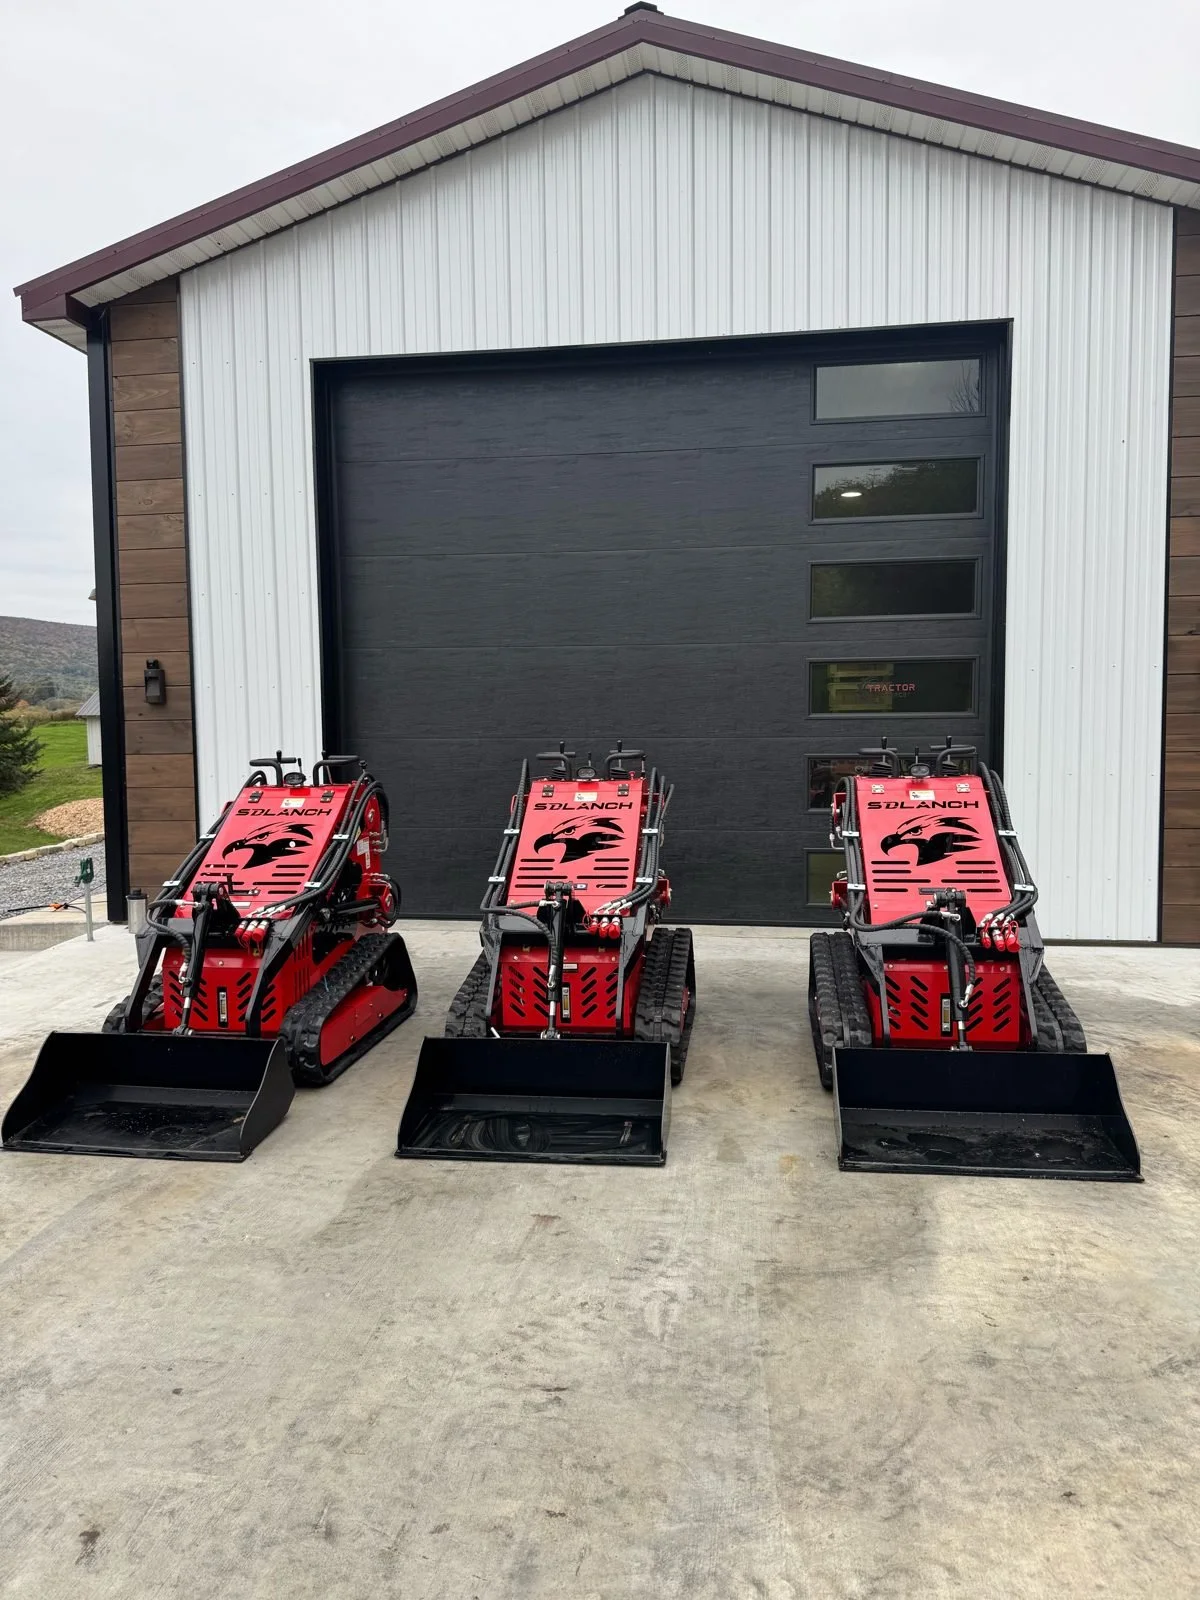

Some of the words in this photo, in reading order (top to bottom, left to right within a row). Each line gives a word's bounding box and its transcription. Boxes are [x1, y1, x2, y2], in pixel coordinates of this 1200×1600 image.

[866, 683, 916, 692] TRACTOR
[534, 802, 633, 811] SDLANCH
[867, 800, 979, 810] SDLANCH
[235, 808, 333, 816] SDLANCH
